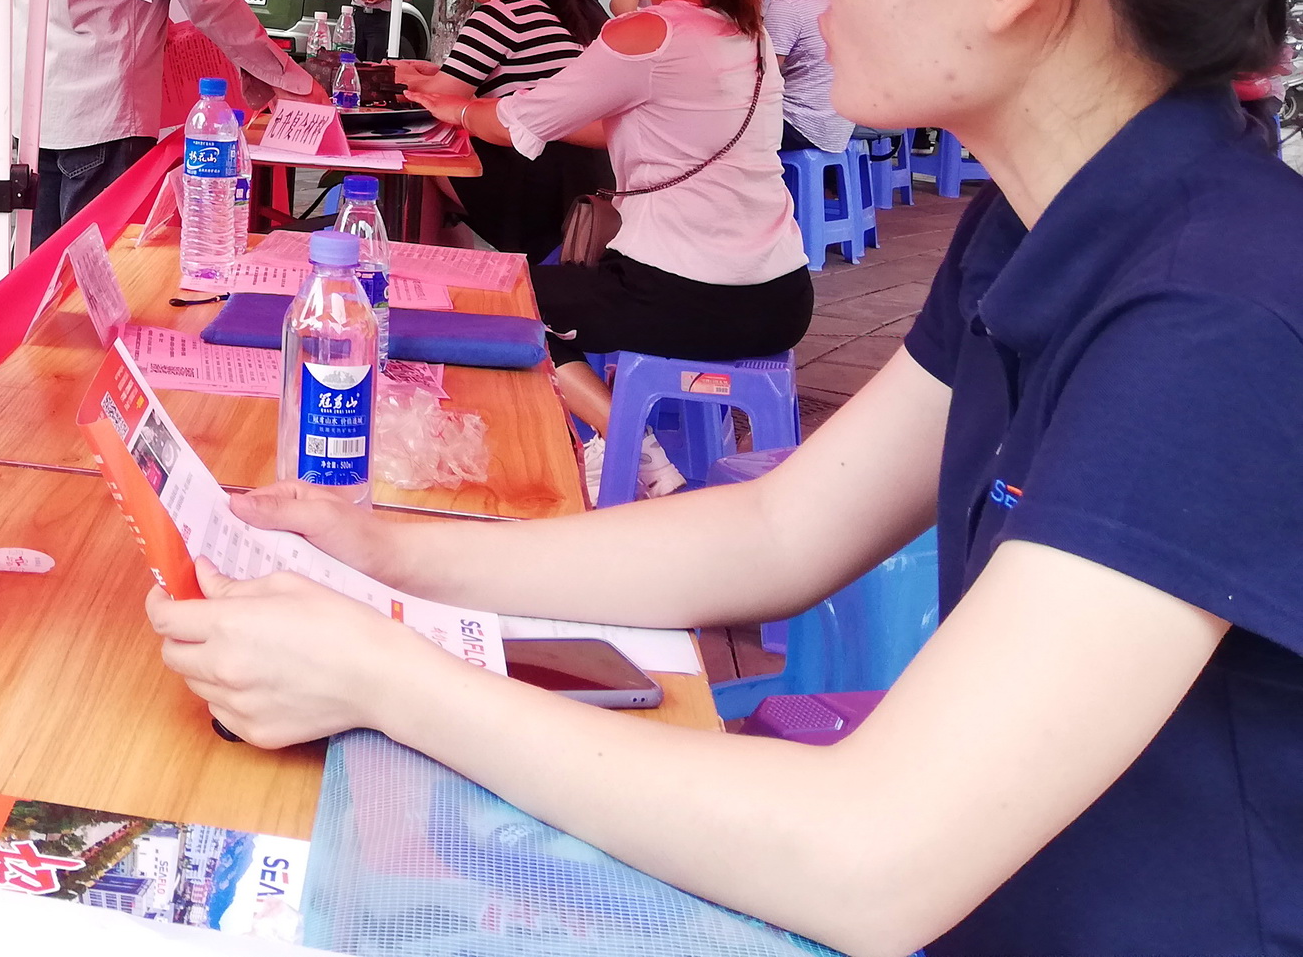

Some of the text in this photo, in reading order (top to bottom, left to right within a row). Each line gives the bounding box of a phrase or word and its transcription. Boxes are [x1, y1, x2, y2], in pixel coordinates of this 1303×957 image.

[460, 618, 487, 668] SEAFLO
[156, 860, 169, 895] SEAFLO
[256, 855, 290, 904] SEA
